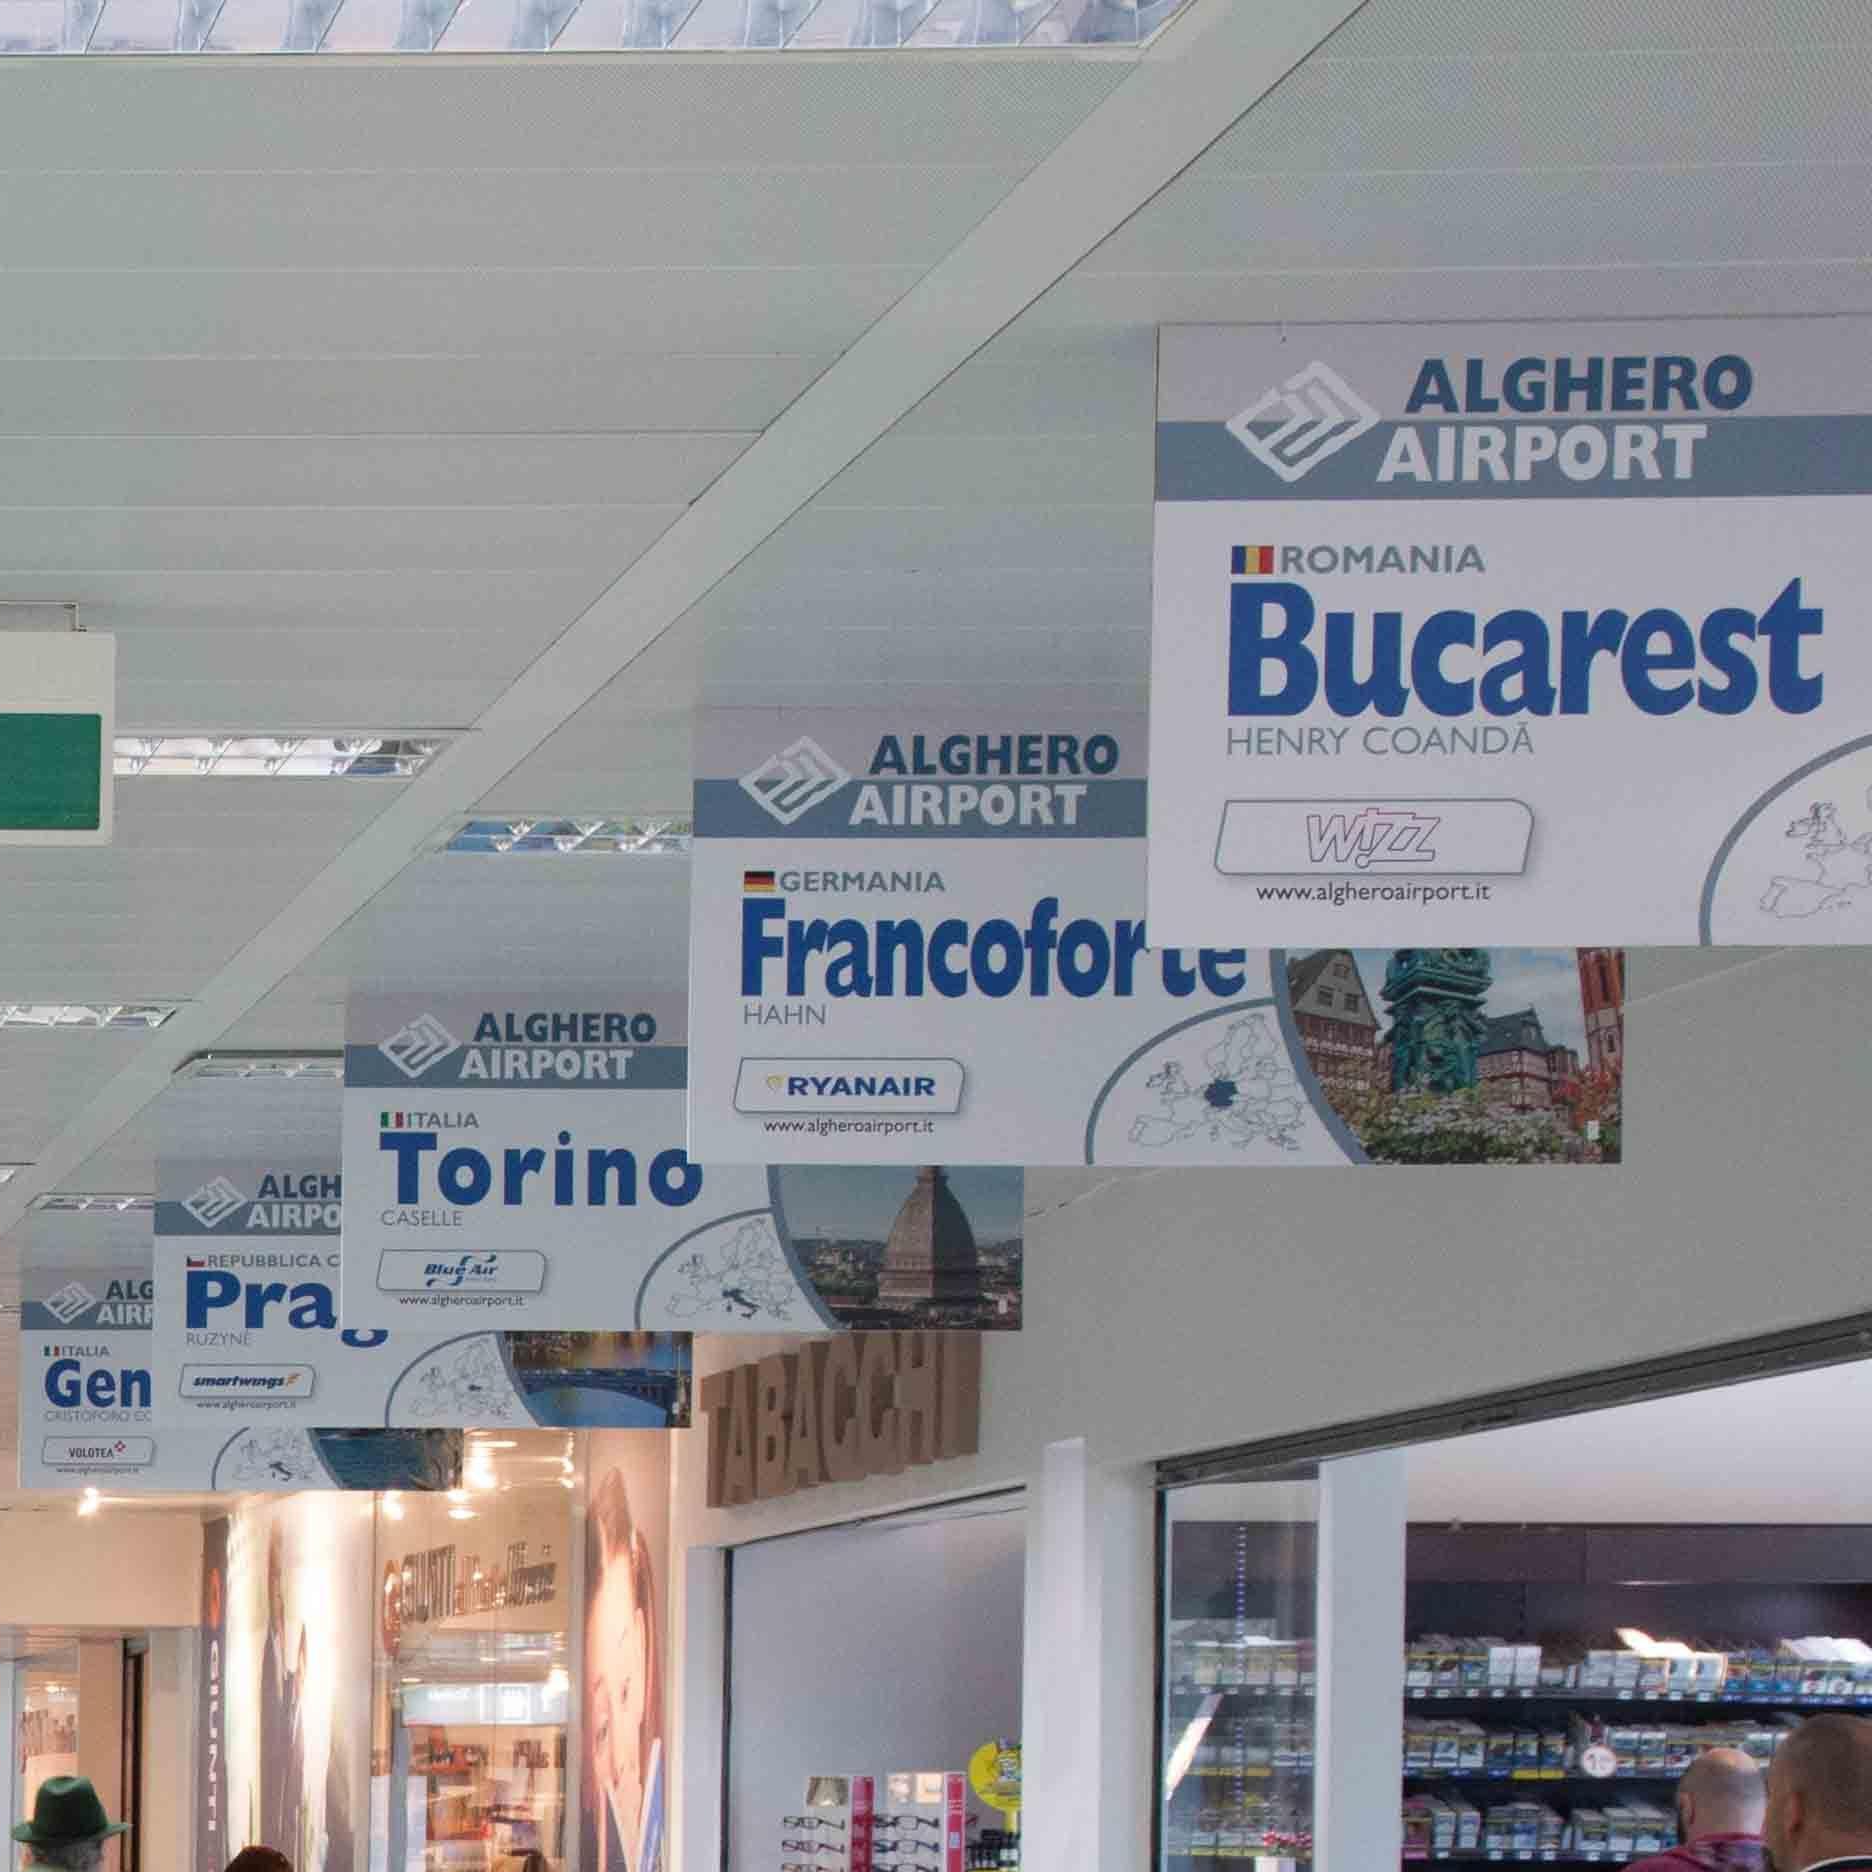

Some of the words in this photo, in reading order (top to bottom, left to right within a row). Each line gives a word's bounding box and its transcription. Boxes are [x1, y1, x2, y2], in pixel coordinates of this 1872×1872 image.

[1405, 354, 1753, 413] ALGHERO
[1376, 424, 1707, 481] AIRPORT
[1281, 545, 1486, 574] ROMANIA
[1227, 576, 1823, 718] Bucarest
[1227, 726, 1348, 755] HENRY
[869, 735, 1119, 775] ALGHERO
[850, 785, 1087, 826] AIRPORT
[779, 872, 946, 893] GERMANIA
[1255, 882, 1491, 904] www.algheroairport.it
[743, 1004, 826, 1025] HAHN
[474, 1012, 657, 1043] ALGHERO
[459, 1049, 633, 1080] AIRPORT
[786, 1076, 935, 1098] RYANAIR
[406, 1112, 479, 1129] ITALIA
[764, 1117, 934, 1136] www.algheroairport.it
[380, 1131, 703, 1207] Torino
[258, 1174, 342, 1199] ALGH
[246, 1204, 341, 1228] AIRPO
[381, 1209, 463, 1226] CASELLE
[208, 1255, 320, 1268] REPUBBLICA
[327, 1255, 340, 1268] C
[106, 1280, 153, 1299] ALG
[399, 1295, 523, 1308] www.algheroairport.it
[63, 1346, 110, 1357] ITALIA
[45, 1359, 151, 1408] Gen
[193, 1375, 284, 1389] smartwings
[701, 1331, 981, 1507] TABACCHI
